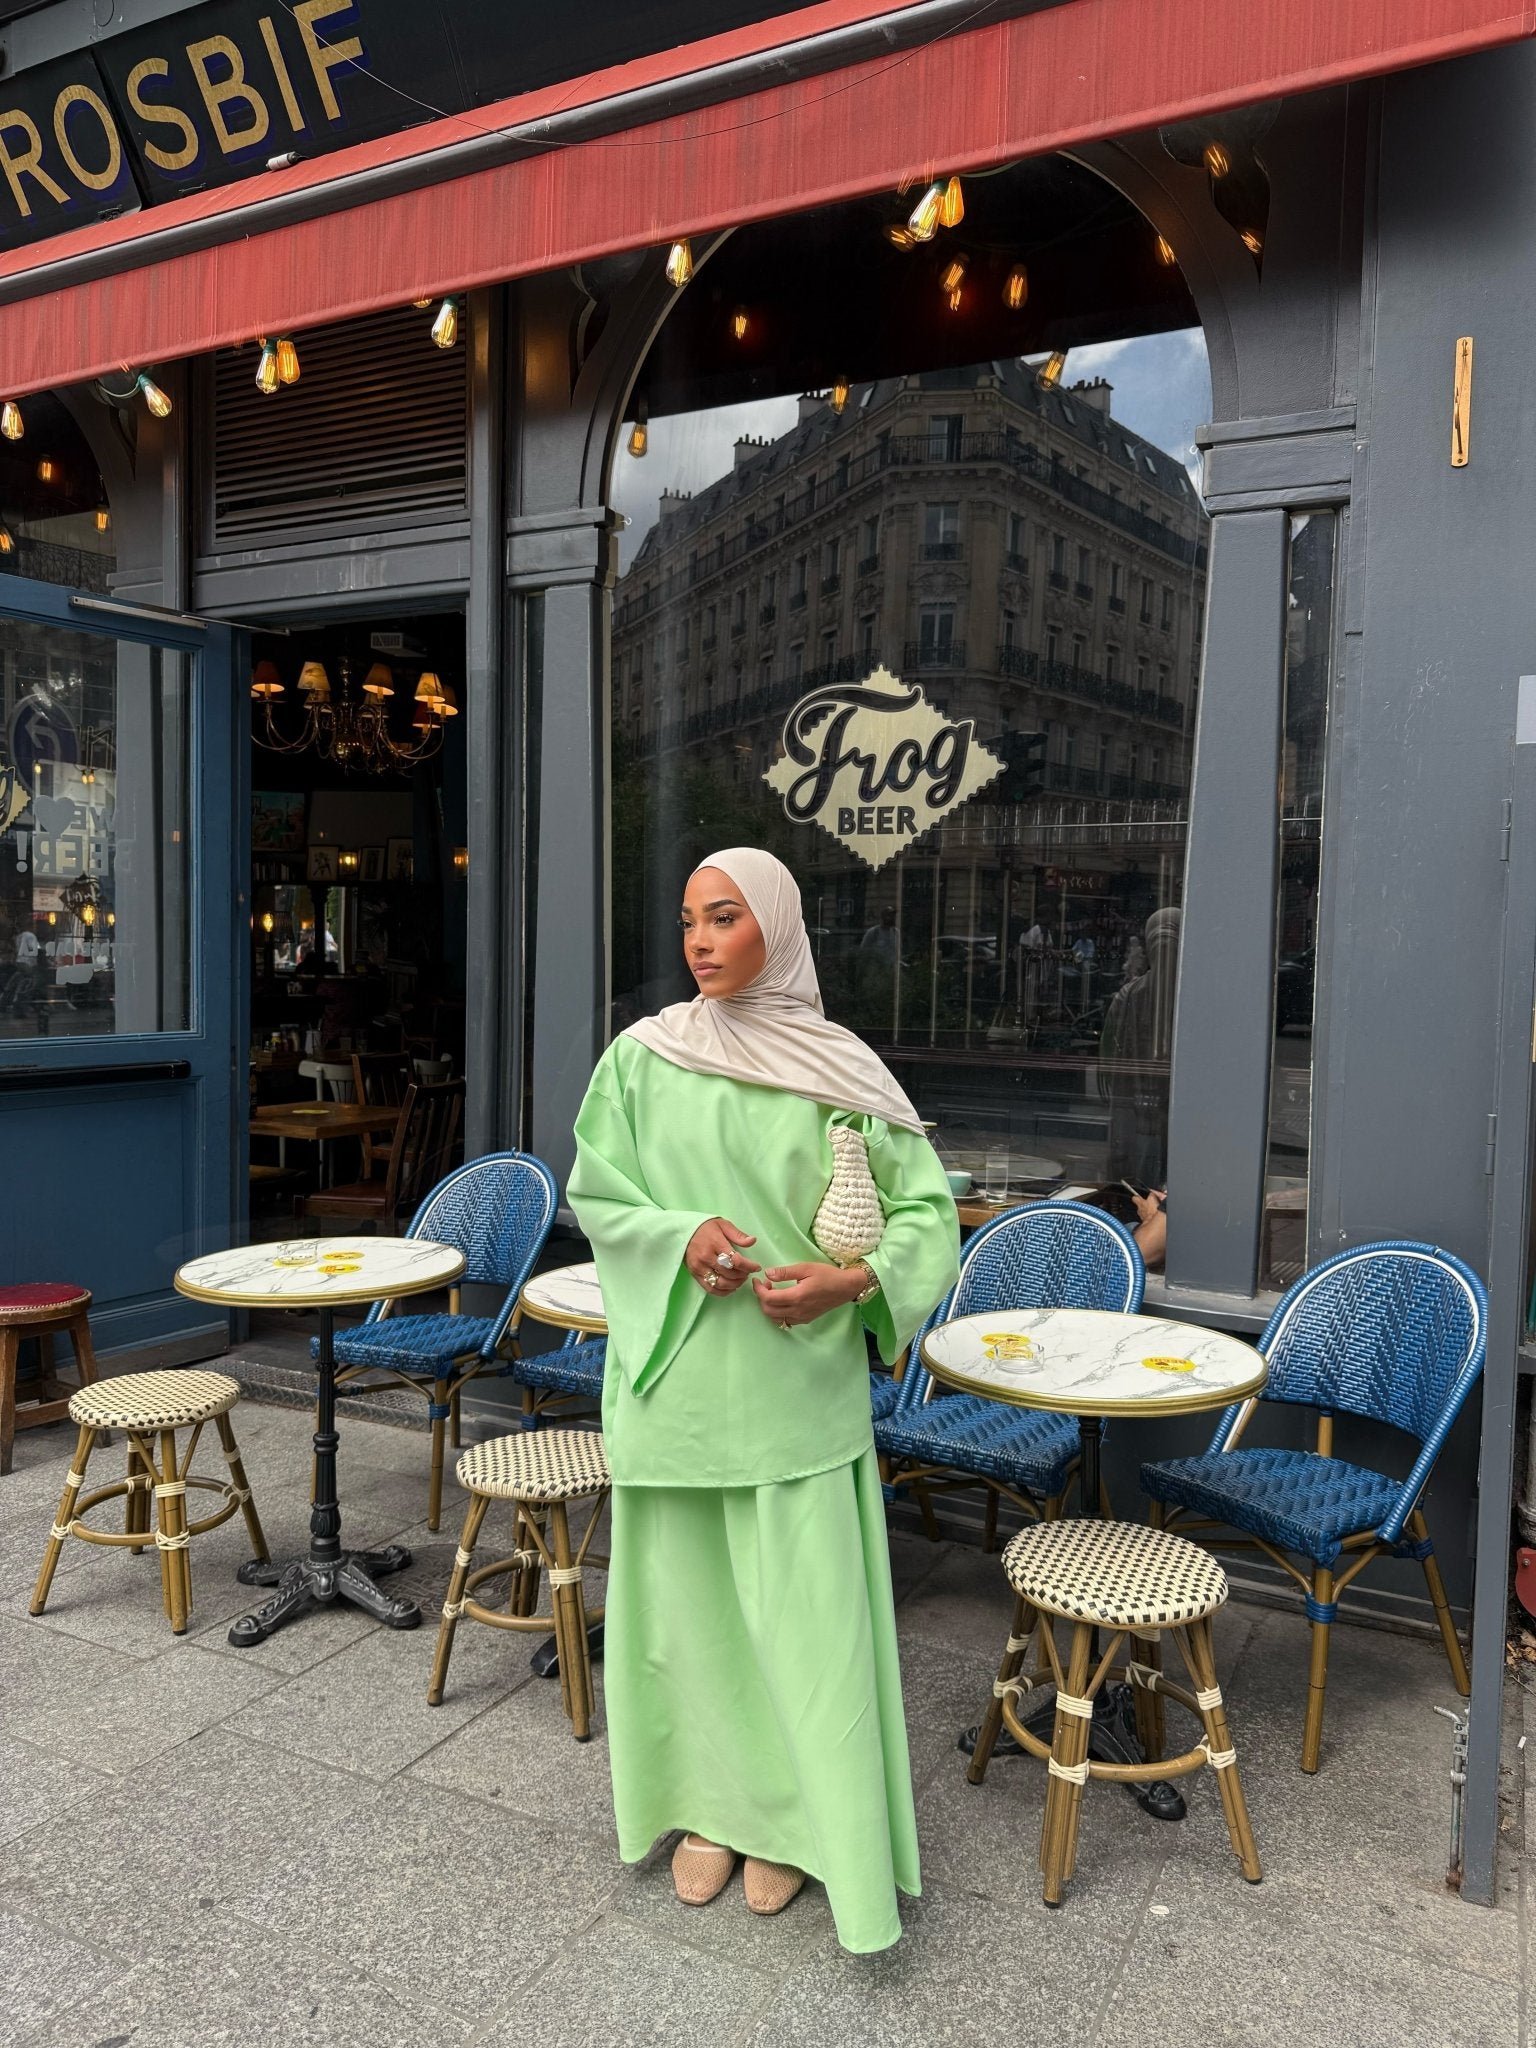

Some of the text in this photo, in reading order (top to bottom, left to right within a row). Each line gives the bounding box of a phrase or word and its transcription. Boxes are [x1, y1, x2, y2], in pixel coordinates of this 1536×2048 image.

[0, 0, 364, 217] ROSBIF
[784, 684, 974, 823] Frog
[837, 805, 919, 836] BEER
